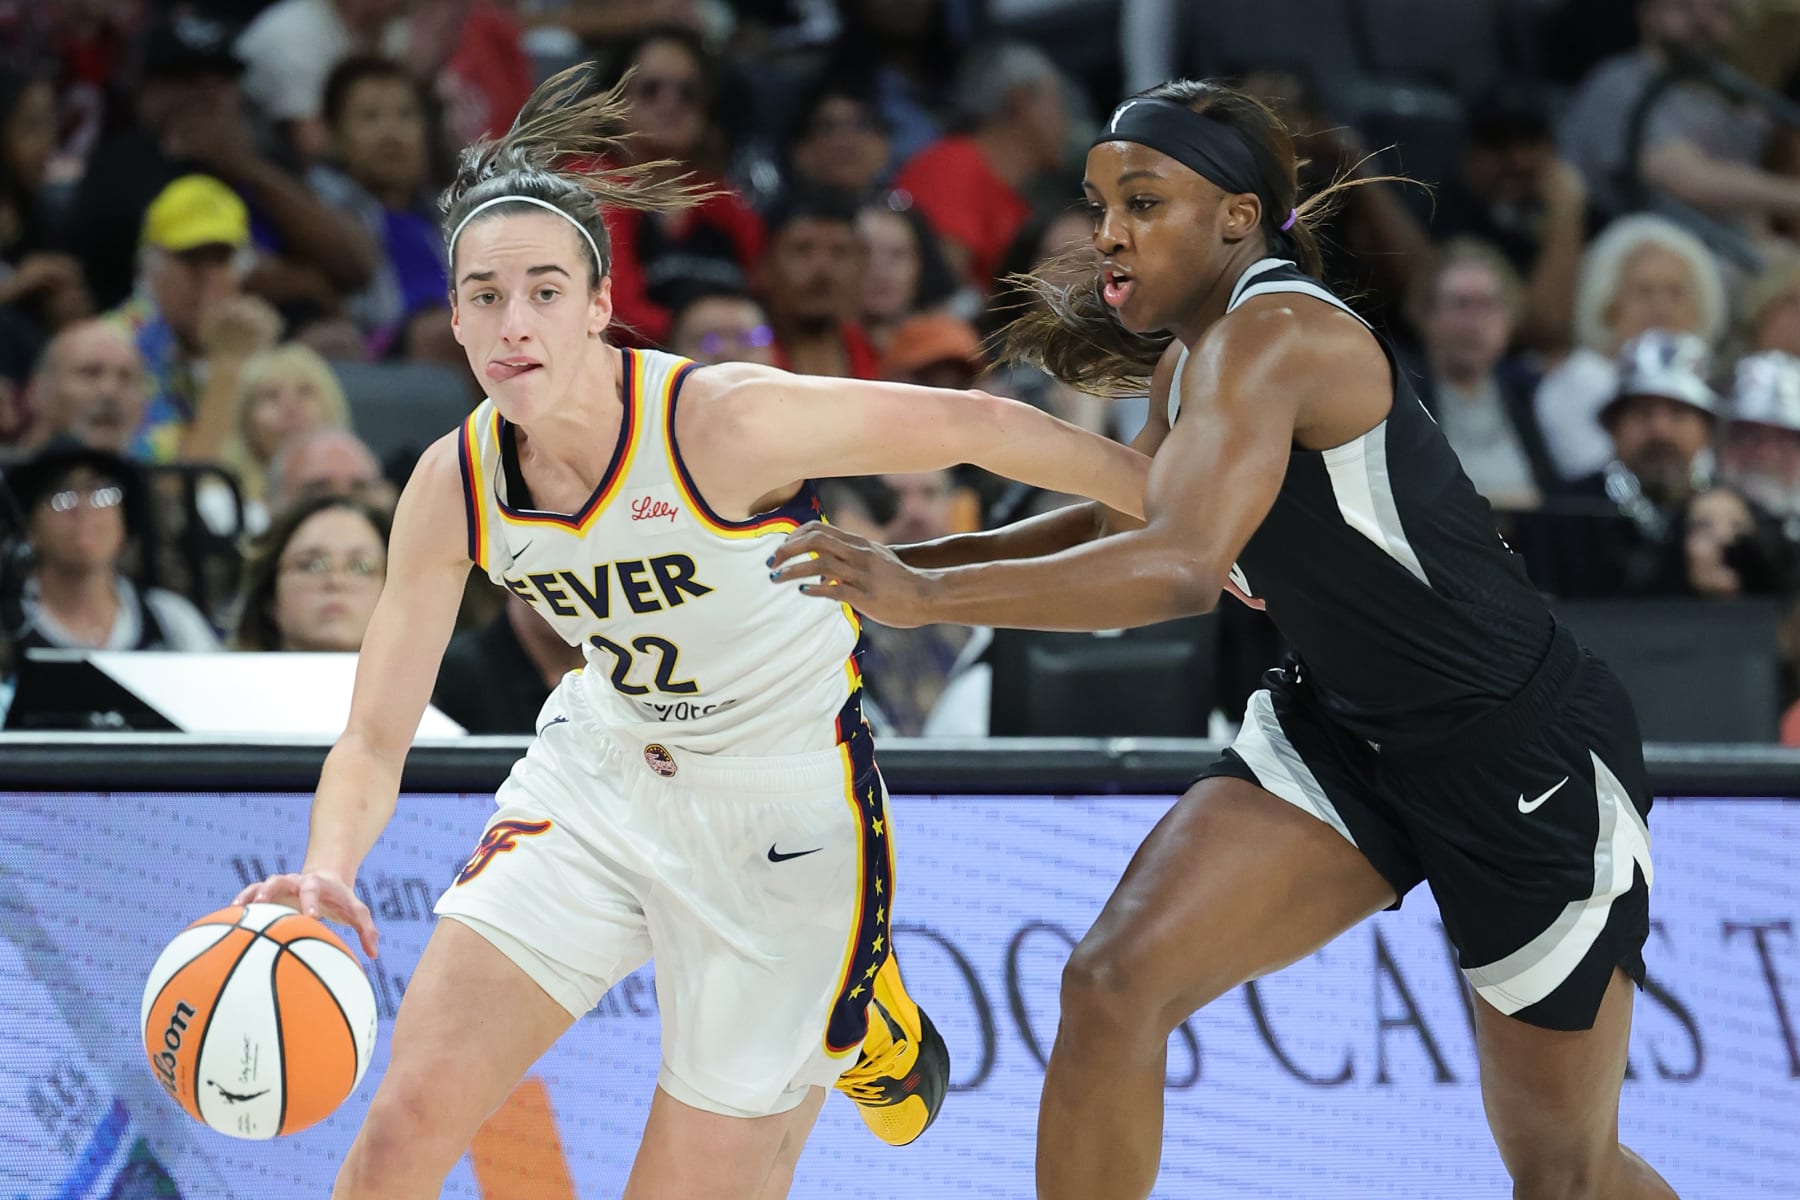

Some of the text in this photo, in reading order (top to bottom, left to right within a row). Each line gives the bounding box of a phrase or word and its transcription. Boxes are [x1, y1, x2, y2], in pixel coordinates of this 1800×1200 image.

[631, 496, 678, 522] Lilly
[503, 552, 716, 620] FEVER
[589, 632, 699, 696] 22
